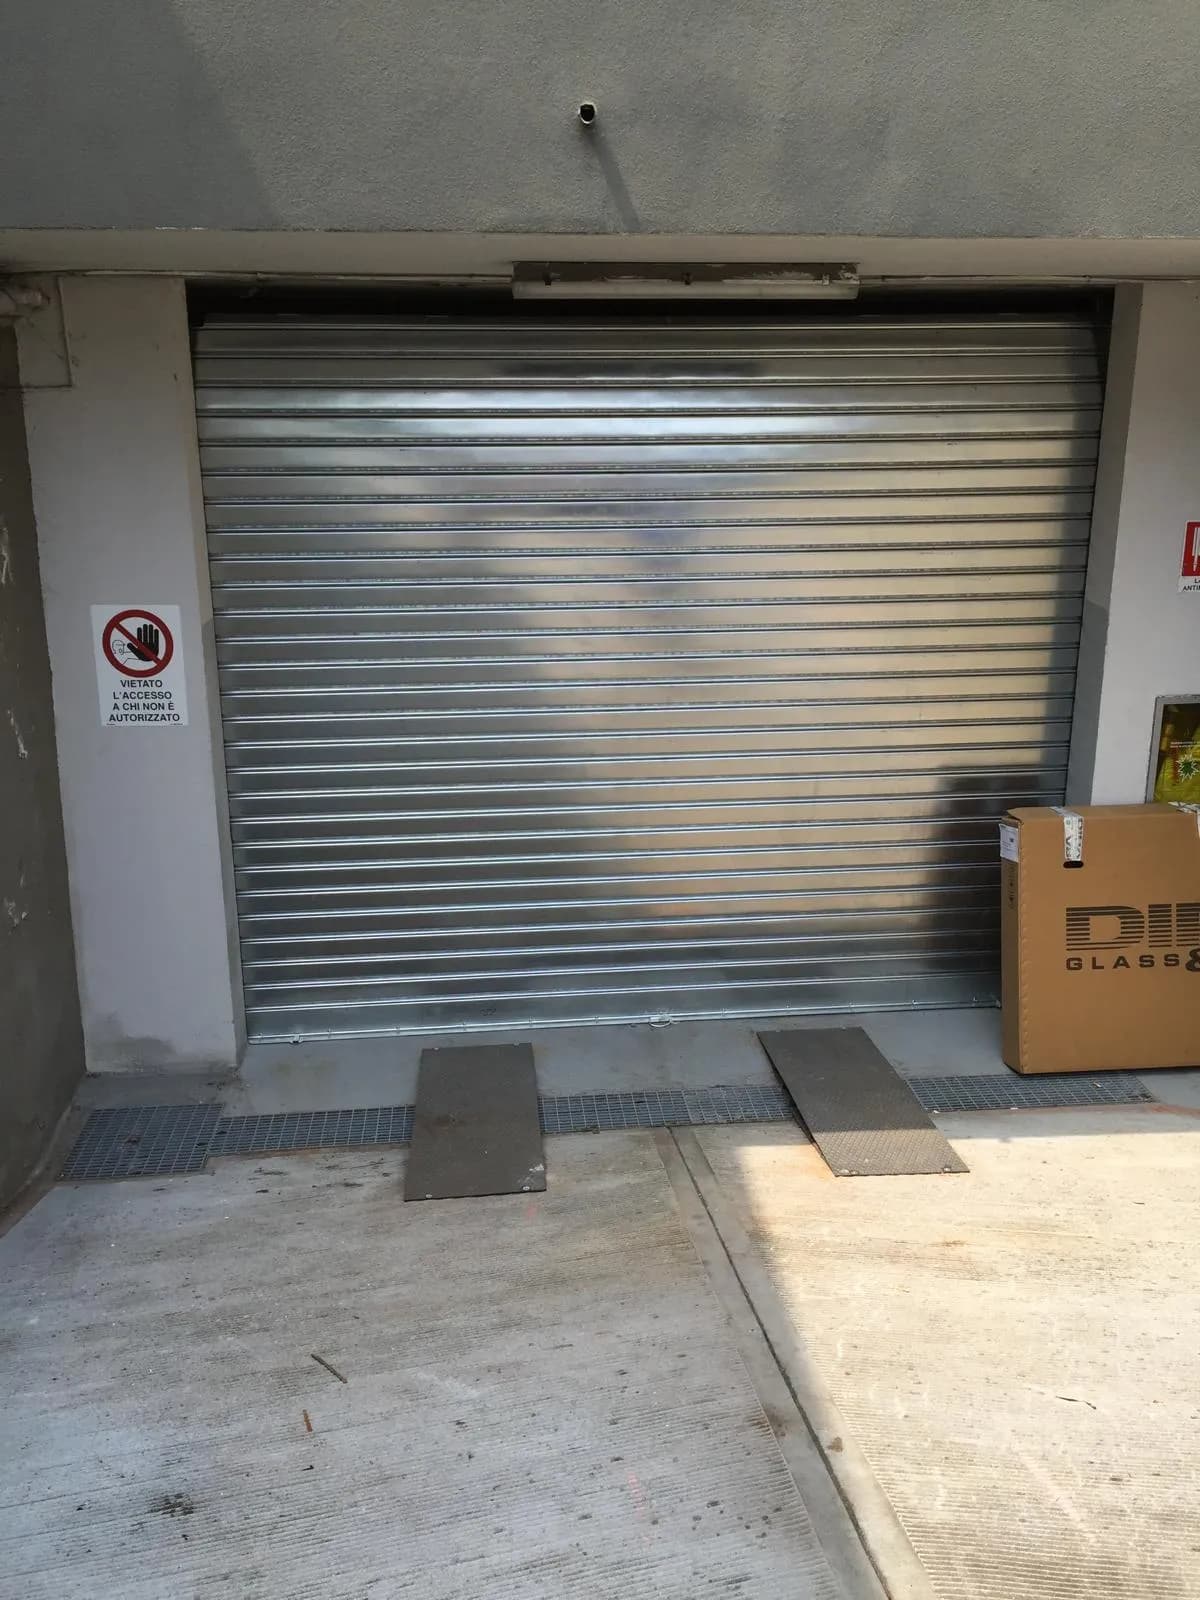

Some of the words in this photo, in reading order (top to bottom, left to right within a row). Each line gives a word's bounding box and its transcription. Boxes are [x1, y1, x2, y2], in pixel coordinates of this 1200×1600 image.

[120, 680, 163, 688] VIETATO
[113, 691, 172, 700] L'ACCESSO
[112, 702, 120, 711] A
[122, 702, 140, 711] CHI
[142, 702, 165, 711] NON
[168, 701, 175, 711] È
[109, 713, 180, 722] AUTORIZZATO
